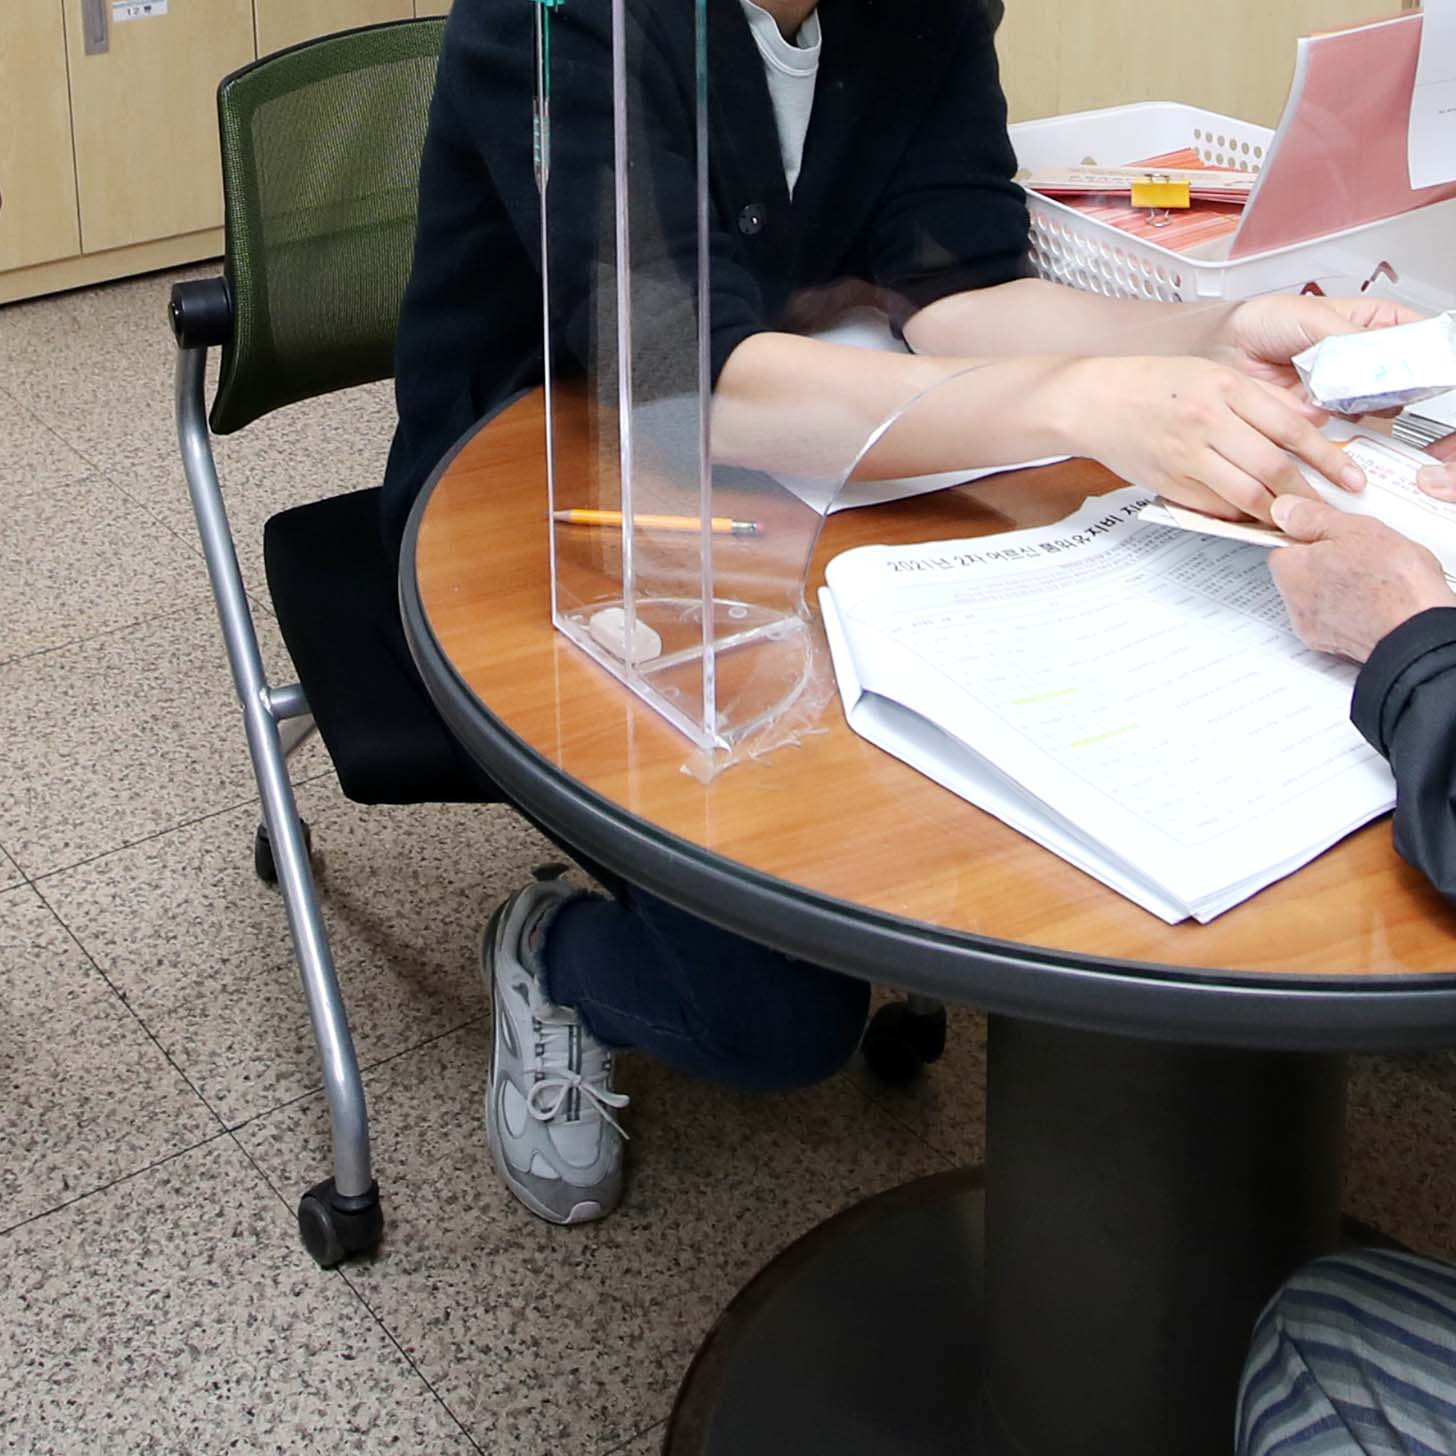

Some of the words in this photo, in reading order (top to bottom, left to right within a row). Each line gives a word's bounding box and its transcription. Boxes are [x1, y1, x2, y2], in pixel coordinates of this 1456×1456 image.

[886, 557, 954, 573] 2021년
[953, 553, 988, 567] 2차
[985, 545, 1041, 562] 어르신
[1039, 514, 1124, 554] 품위유지비
